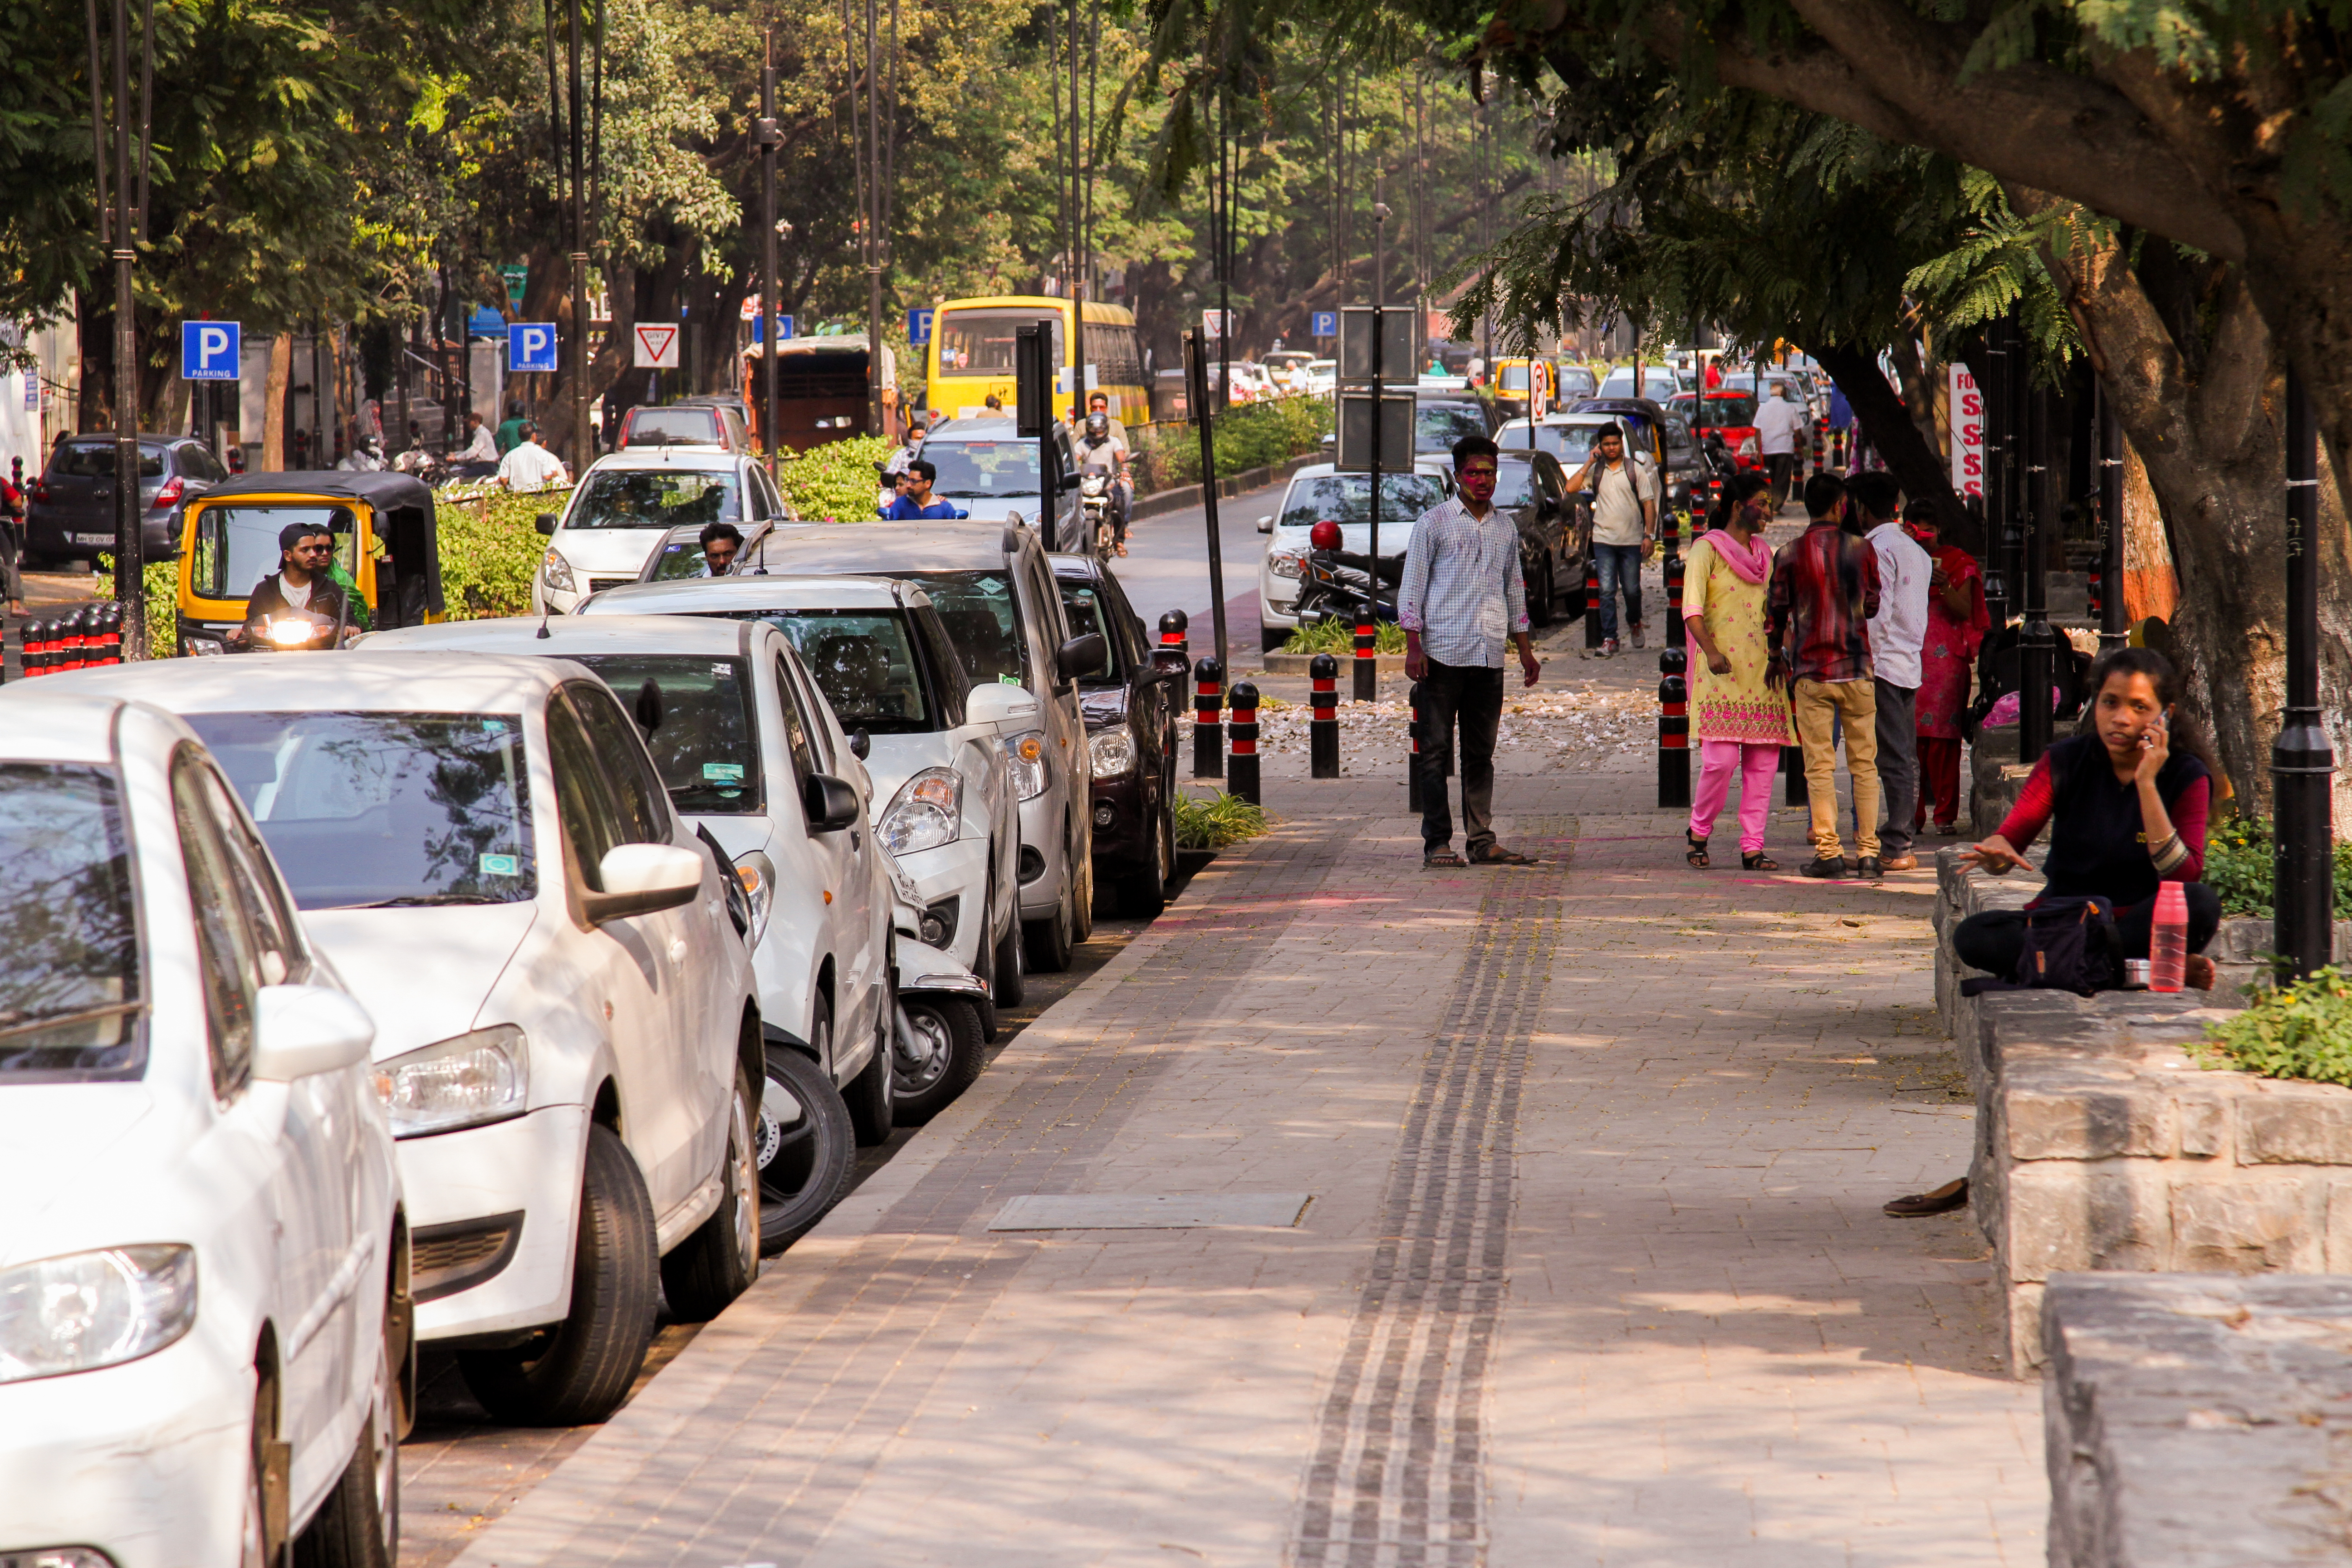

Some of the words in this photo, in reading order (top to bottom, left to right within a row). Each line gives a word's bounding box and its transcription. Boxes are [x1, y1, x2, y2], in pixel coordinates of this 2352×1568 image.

[919, 312, 933, 338] P
[1319, 314, 1332, 331] P
[200, 327, 229, 368] P
[523, 328, 547, 363] P
[192, 369, 231, 377] PARKING
[1957, 373, 1978, 390] FO
